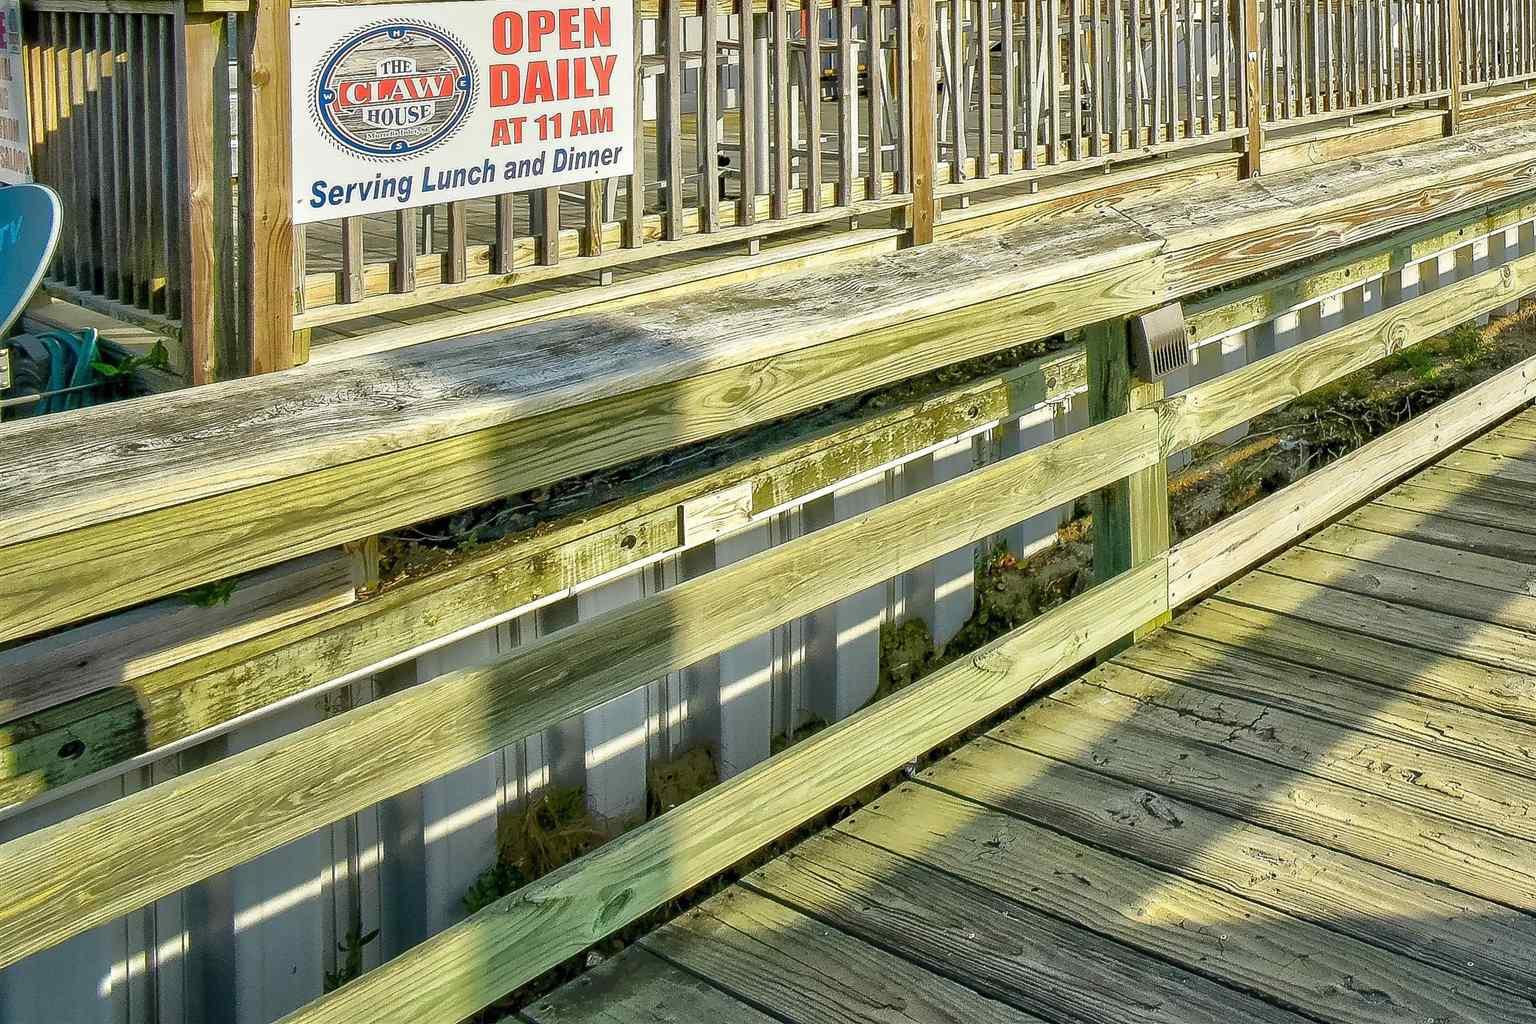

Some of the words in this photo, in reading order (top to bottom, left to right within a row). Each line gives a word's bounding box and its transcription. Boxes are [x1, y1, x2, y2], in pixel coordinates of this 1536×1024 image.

[492, 6, 611, 55] OPEN
[380, 59, 412, 75] THE
[489, 55, 618, 107] DAILY
[346, 75, 446, 105] CLAW
[367, 104, 431, 126] HOUSE
[491, 116, 528, 147] AT
[534, 113, 561, 141] 11
[569, 107, 614, 136] AM
[310, 172, 413, 208] Serving
[421, 159, 495, 193] Lunch
[504, 151, 545, 179] and
[552, 145, 622, 173] Dinner
